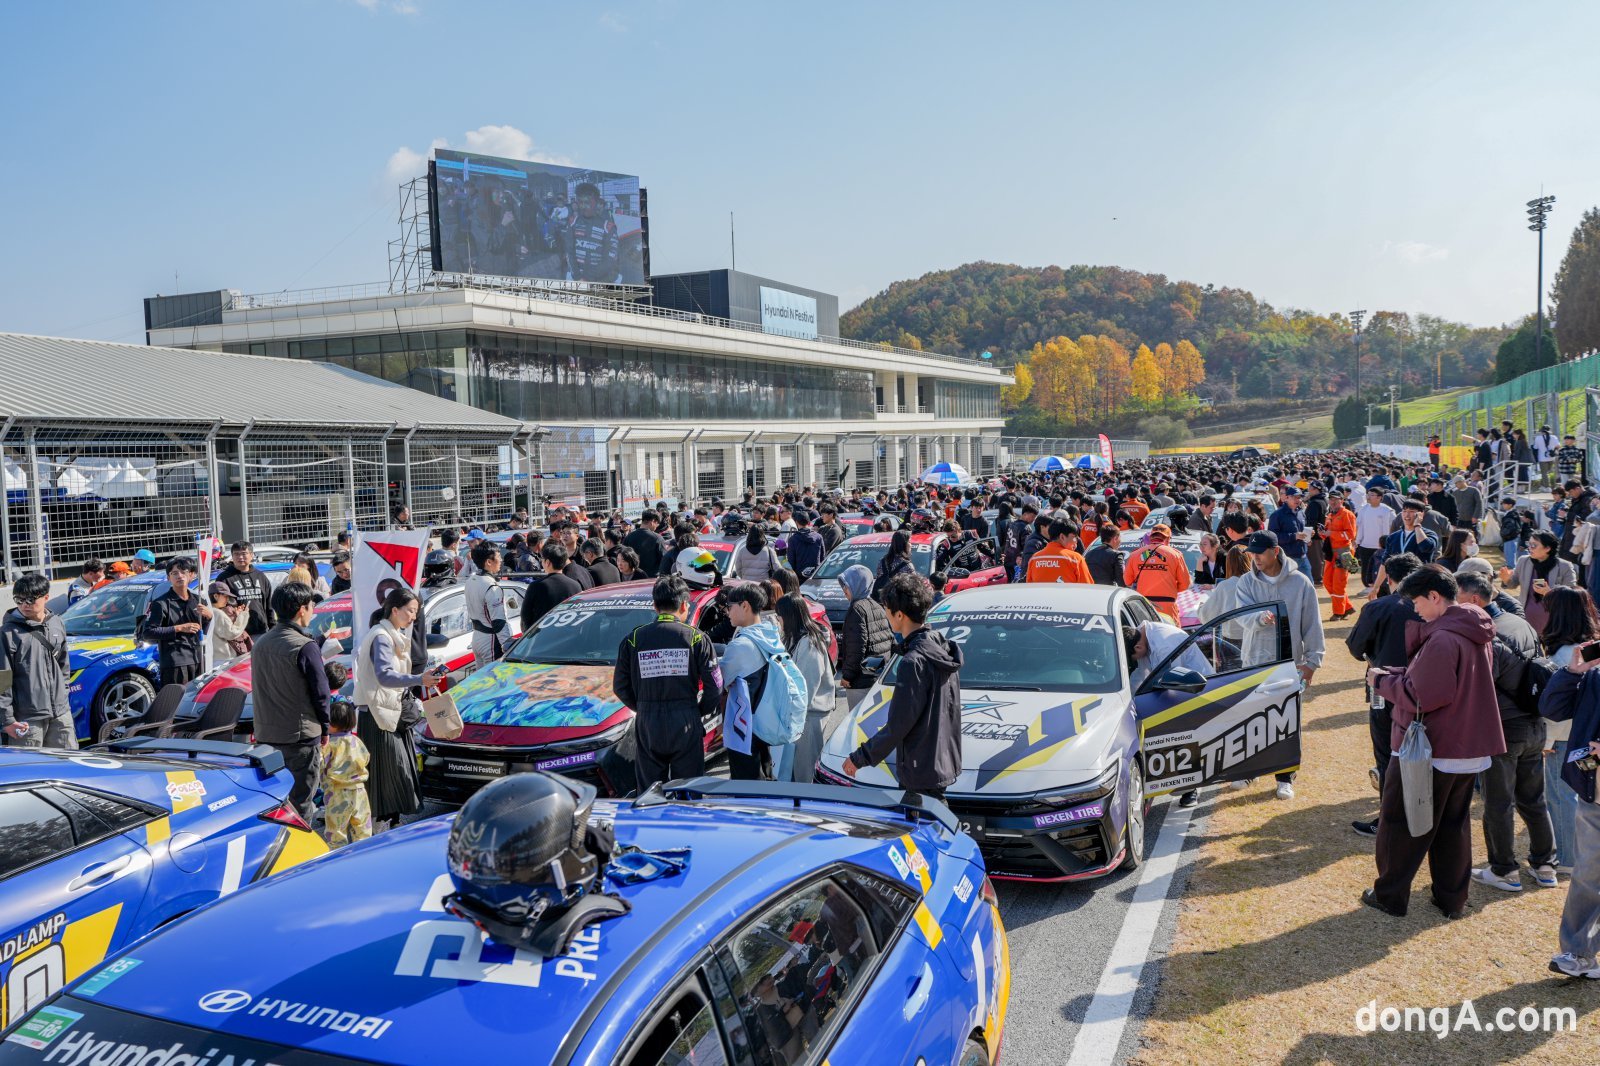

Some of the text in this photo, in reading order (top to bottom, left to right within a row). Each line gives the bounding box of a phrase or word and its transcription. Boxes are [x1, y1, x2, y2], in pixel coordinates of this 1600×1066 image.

[764, 303, 815, 324] Hyundai N Festival
[1145, 518, 1165, 527] 01
[826, 550, 862, 561] 072
[917, 543, 932, 554] B
[1035, 560, 1061, 569] OFFICIAL
[1137, 563, 1170, 571] OFFICIAL
[571, 599, 616, 610] Hyundai
[626, 599, 654, 607] Festi
[538, 610, 597, 629] 097
[951, 612, 1013, 623] Hyundai
[1015, 613, 1027, 622] N
[1027, 613, 1086, 626] Festival
[1145, 737, 1165, 748] yundai
[1171, 733, 1193, 742] Festival
[1201, 695, 1298, 780] TEAM
[537, 752, 593, 771] NEXEN TIRE
[1148, 748, 1193, 777] 012
[448, 763, 473, 774] Hyundai
[478, 766, 501, 775] Festival
[1160, 775, 1196, 788] NEXEN TIRE
[1036, 805, 1103, 827] NEXEN TIRE
[555, 922, 601, 981] PRE
[249, 997, 394, 1040] HYUNDAI
